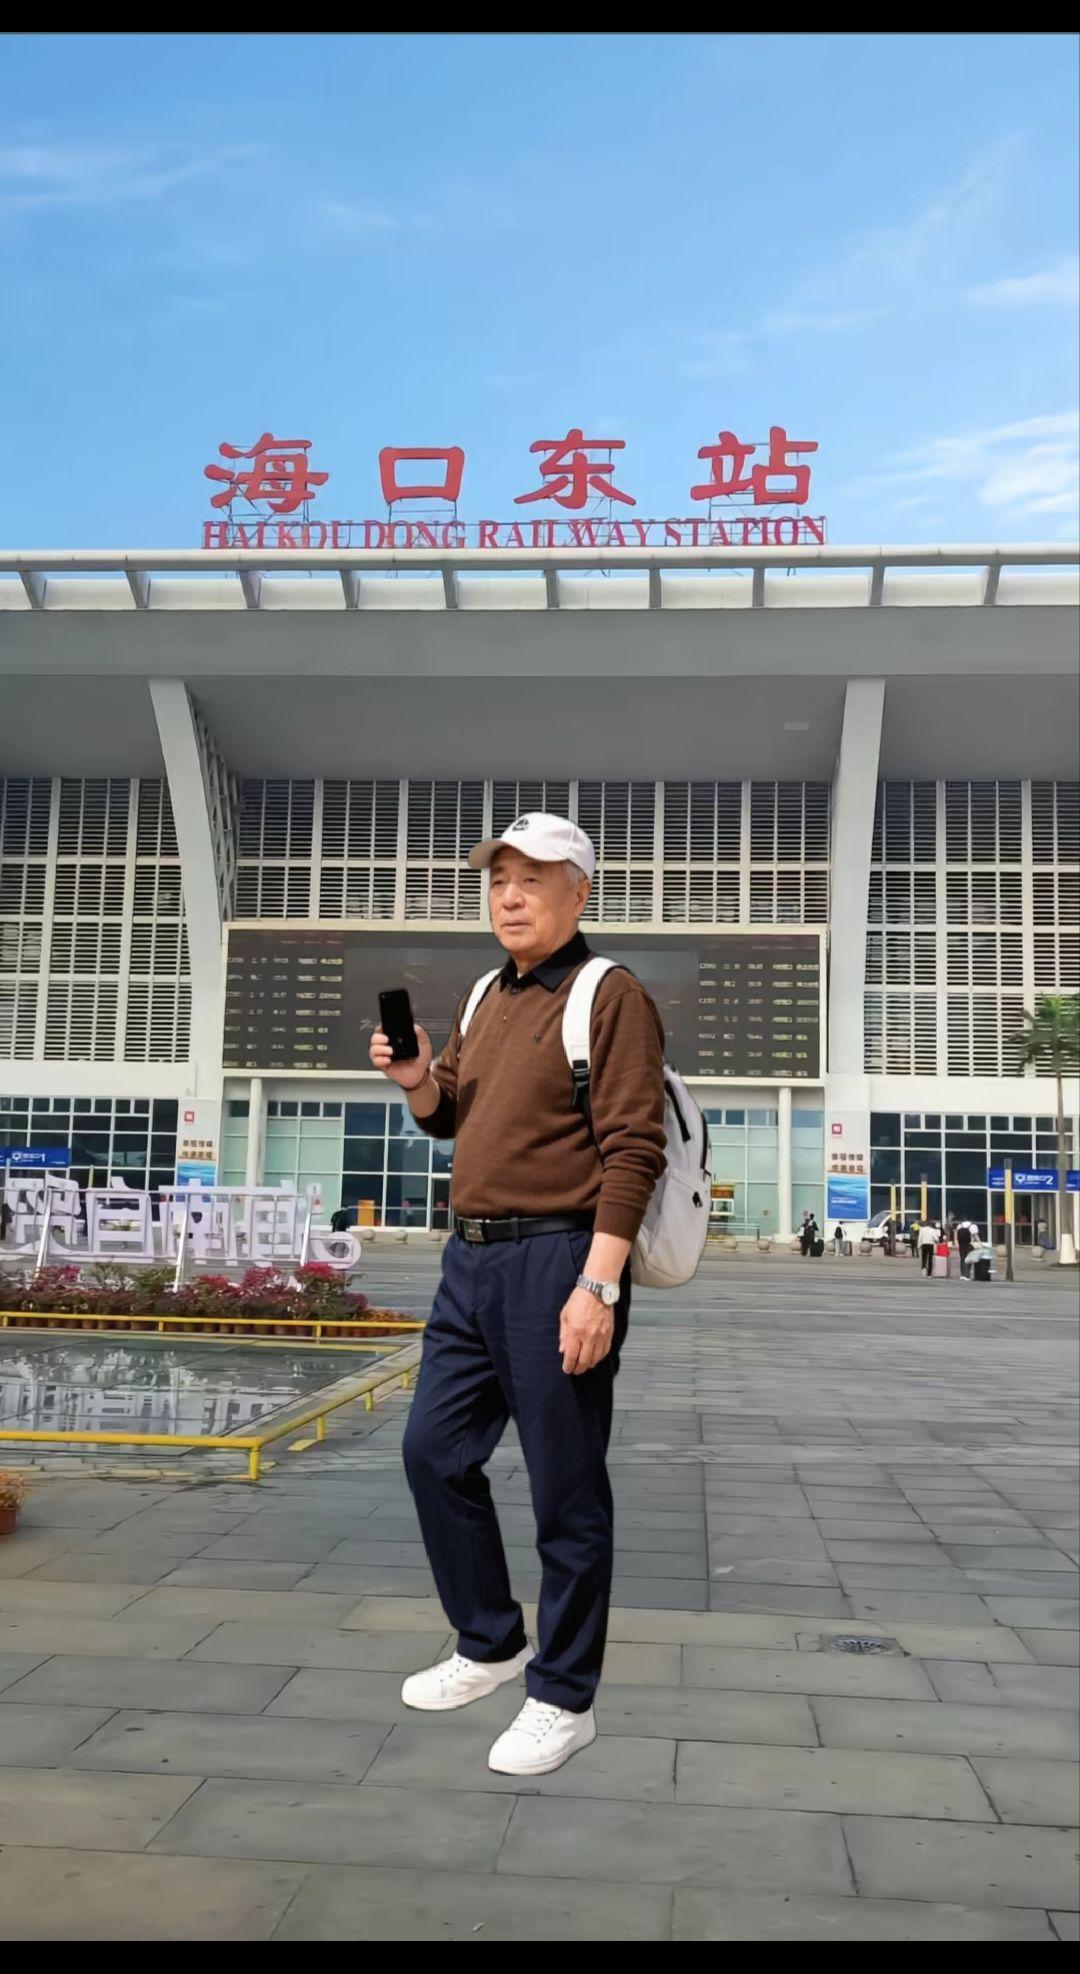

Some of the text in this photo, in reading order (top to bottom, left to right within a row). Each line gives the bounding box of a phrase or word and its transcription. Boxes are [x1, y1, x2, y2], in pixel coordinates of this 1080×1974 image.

[204, 426, 820, 513] 海口东站
[363, 521, 466, 549] DONG
[480, 519, 655, 548] RAILWAY
[664, 516, 827, 547] STATION
